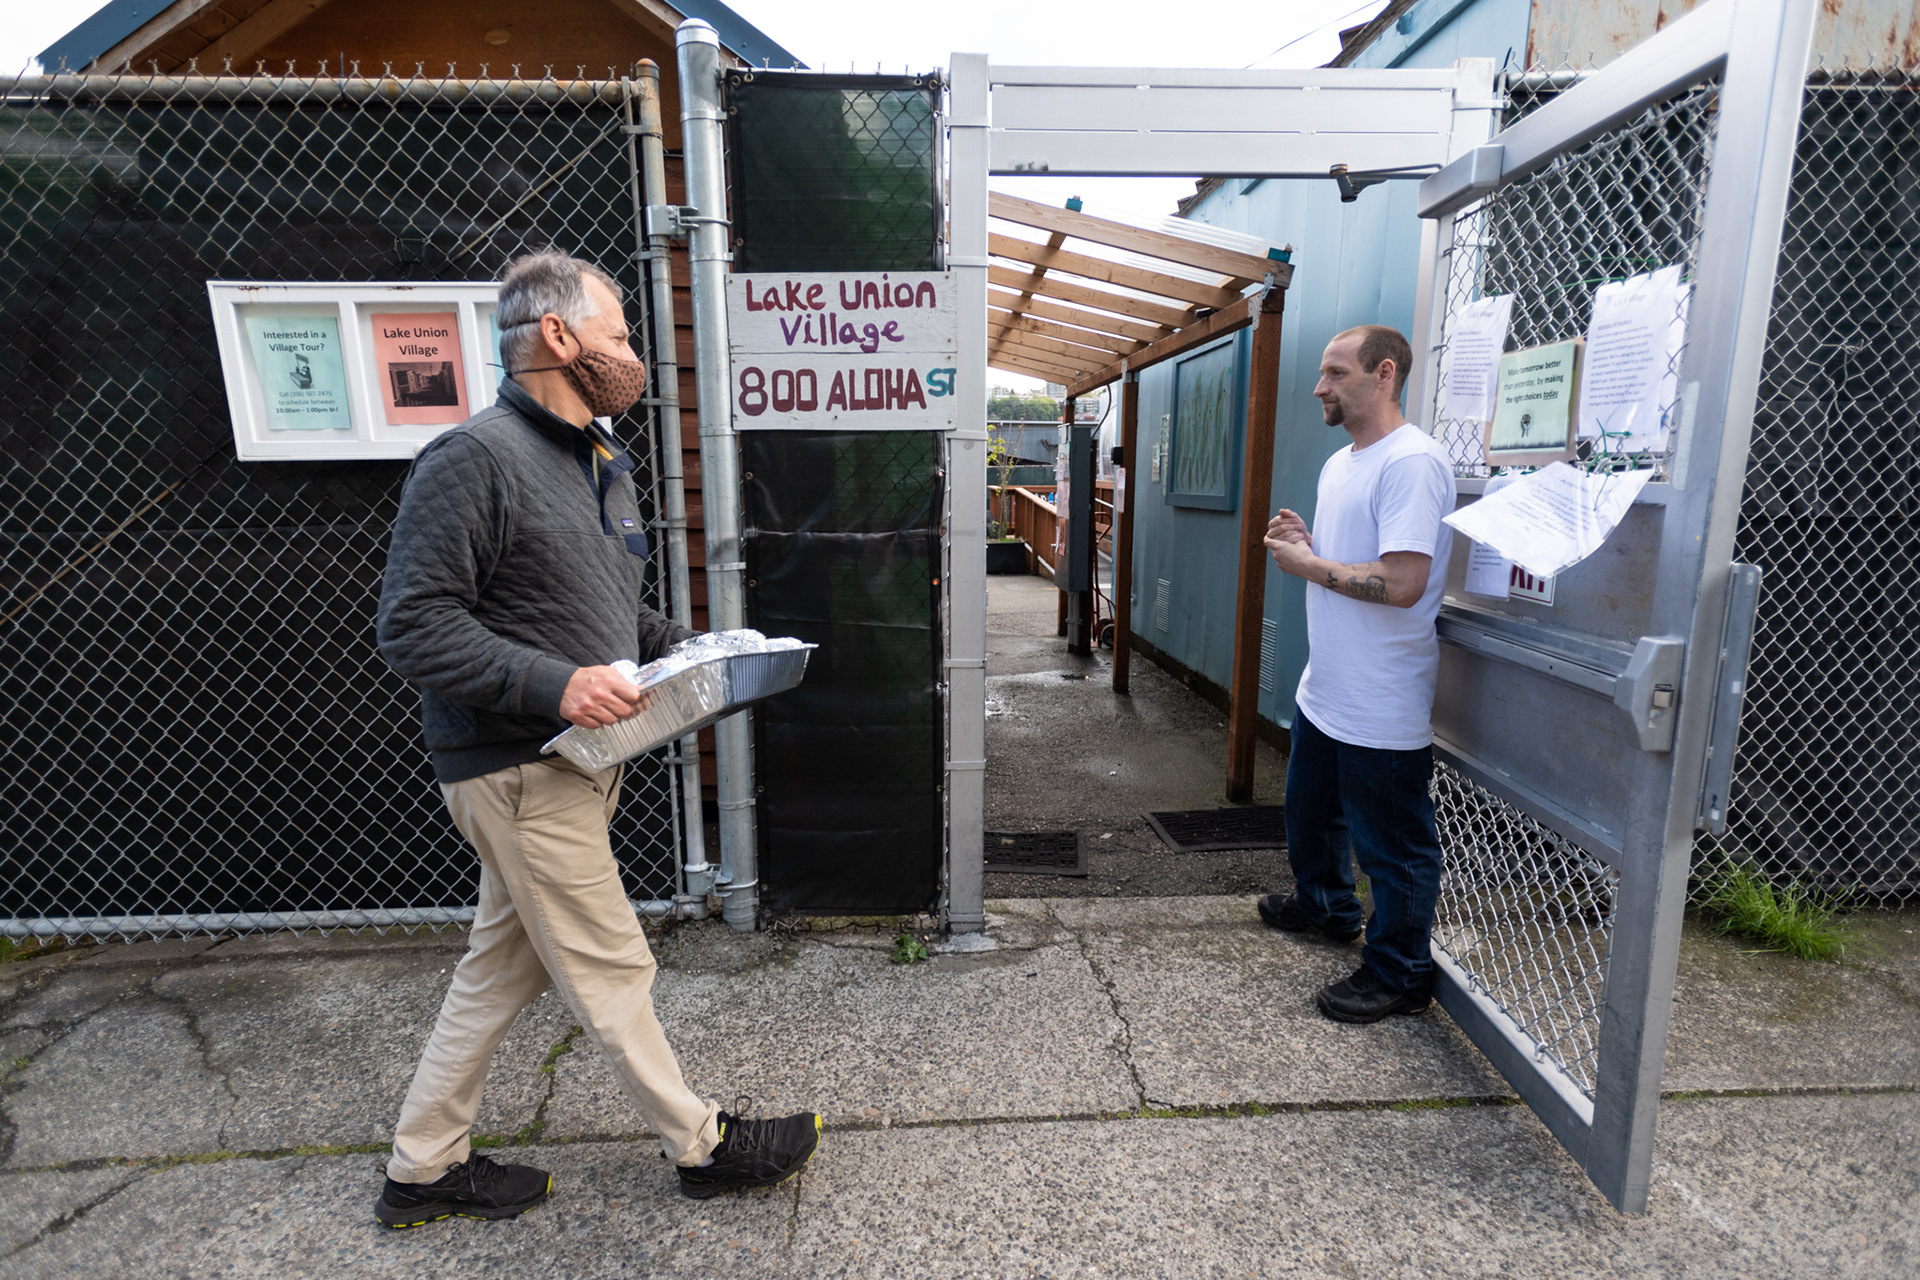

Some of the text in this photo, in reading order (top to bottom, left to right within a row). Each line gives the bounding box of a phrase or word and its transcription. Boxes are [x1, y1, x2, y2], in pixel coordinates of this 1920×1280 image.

[746, 279, 826, 311] Lake
[263, 331, 309, 339] Interested
[383, 327, 449, 338] Lake Union
[780, 312, 904, 353] Village
[269, 343, 325, 353] Village Tour?
[399, 344, 438, 358] Village
[1520, 364, 1544, 374] tomorrow
[1545, 360, 1562, 369] better
[1536, 377, 1544, 386] by
[1544, 374, 1564, 383] making
[739, 367, 957, 416] 800 ALOHA ST
[1505, 389, 1559, 404] the right choices today
